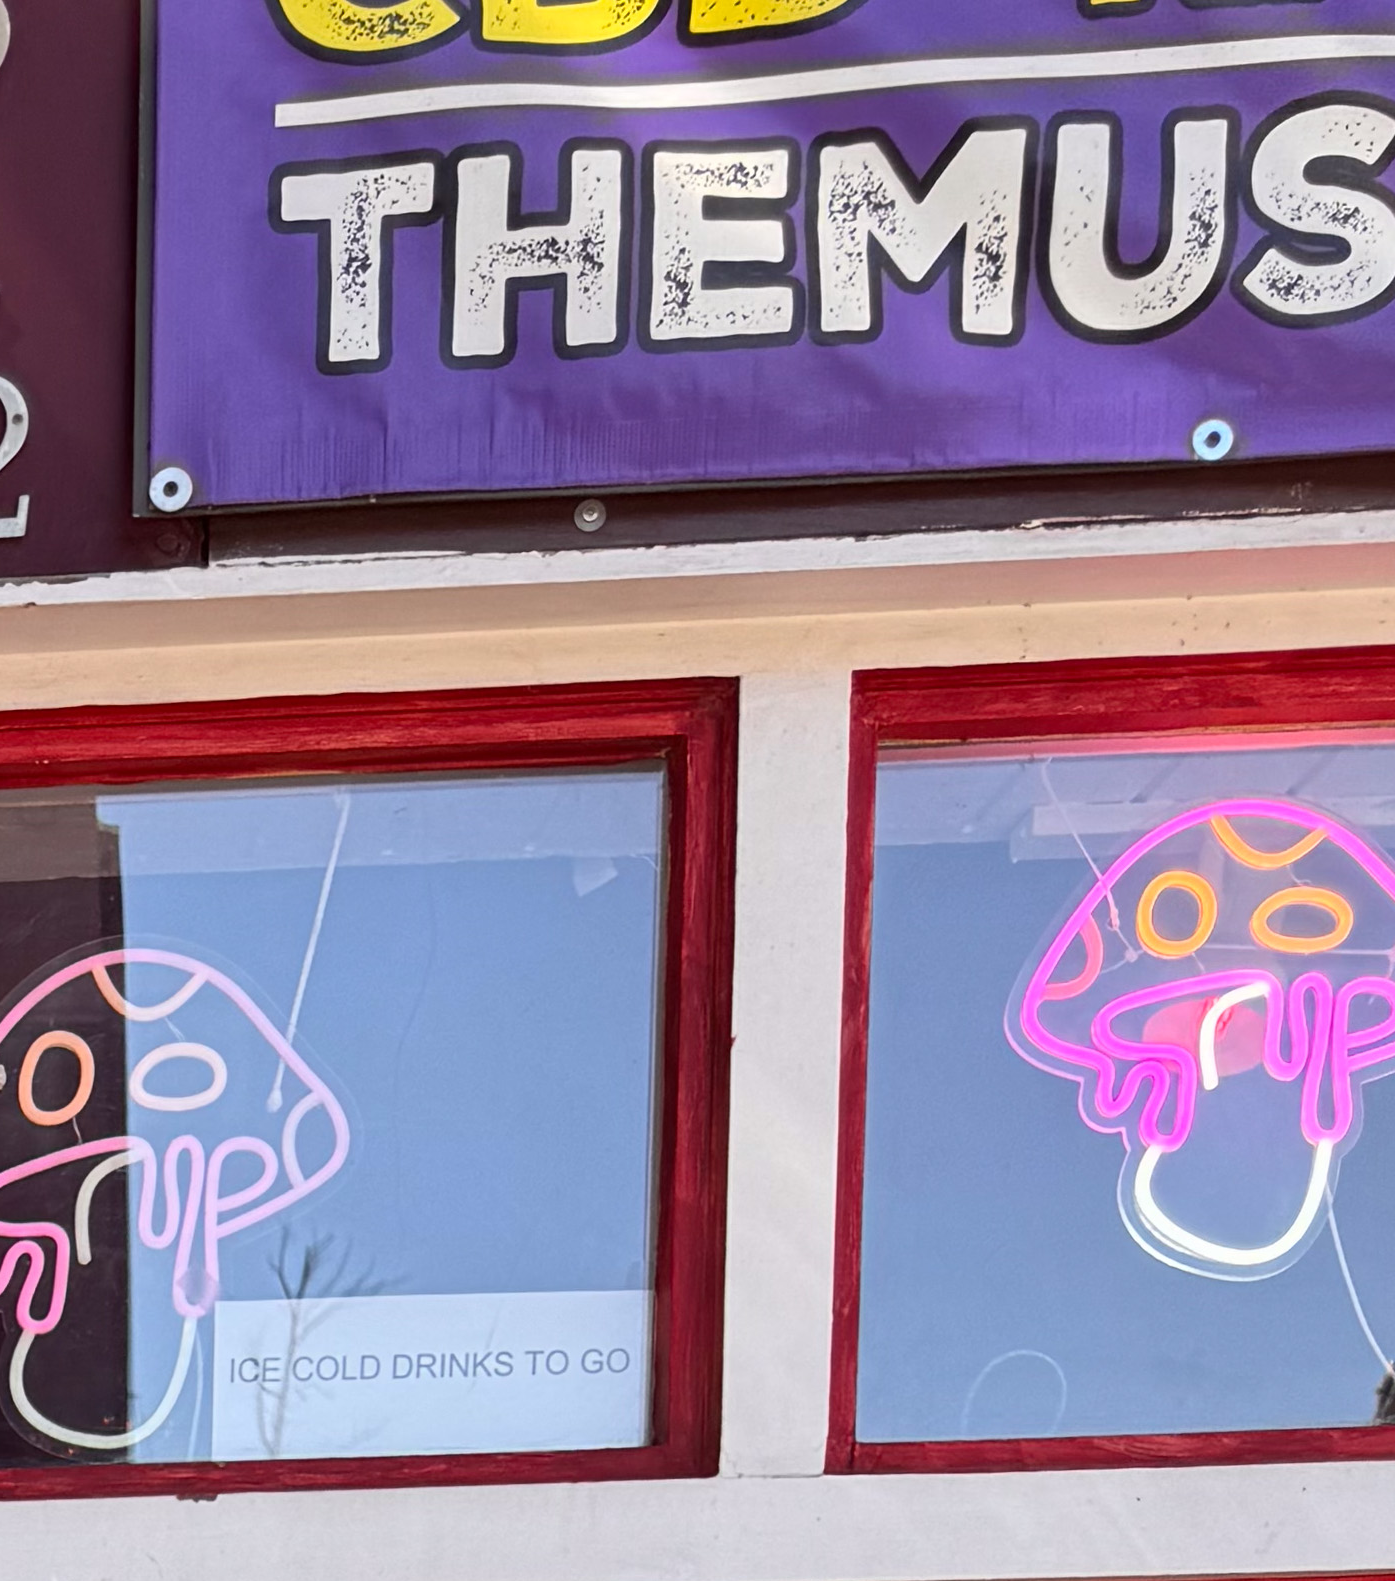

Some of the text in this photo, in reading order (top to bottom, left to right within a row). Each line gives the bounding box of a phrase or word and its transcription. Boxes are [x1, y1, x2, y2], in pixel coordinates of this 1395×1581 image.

[279, 104, 1395, 364] THEMUS
[230, 1347, 630, 1383] ICE COLD DRINKS TO GO
